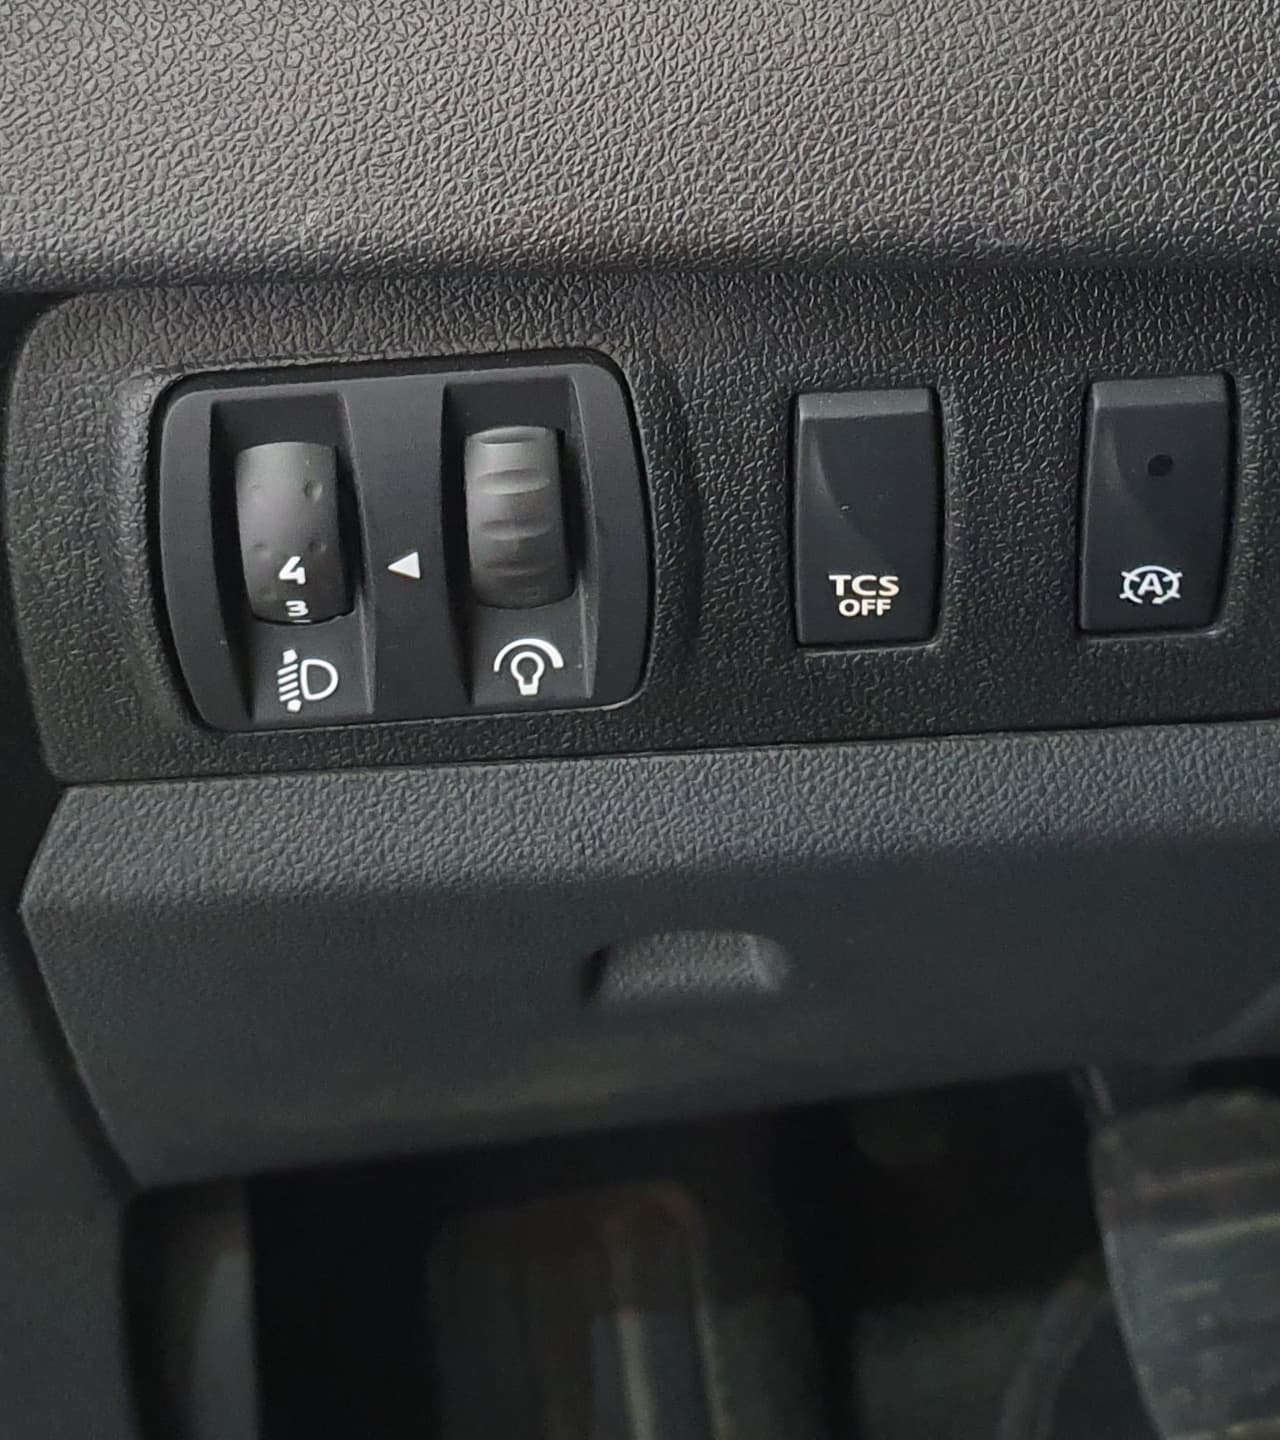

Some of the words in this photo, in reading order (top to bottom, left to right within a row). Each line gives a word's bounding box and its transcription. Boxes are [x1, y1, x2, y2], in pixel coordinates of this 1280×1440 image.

[278, 555, 307, 585] 4
[828, 574, 900, 597] TCS
[285, 599, 309, 617] 3
[838, 598, 892, 617] OFF
